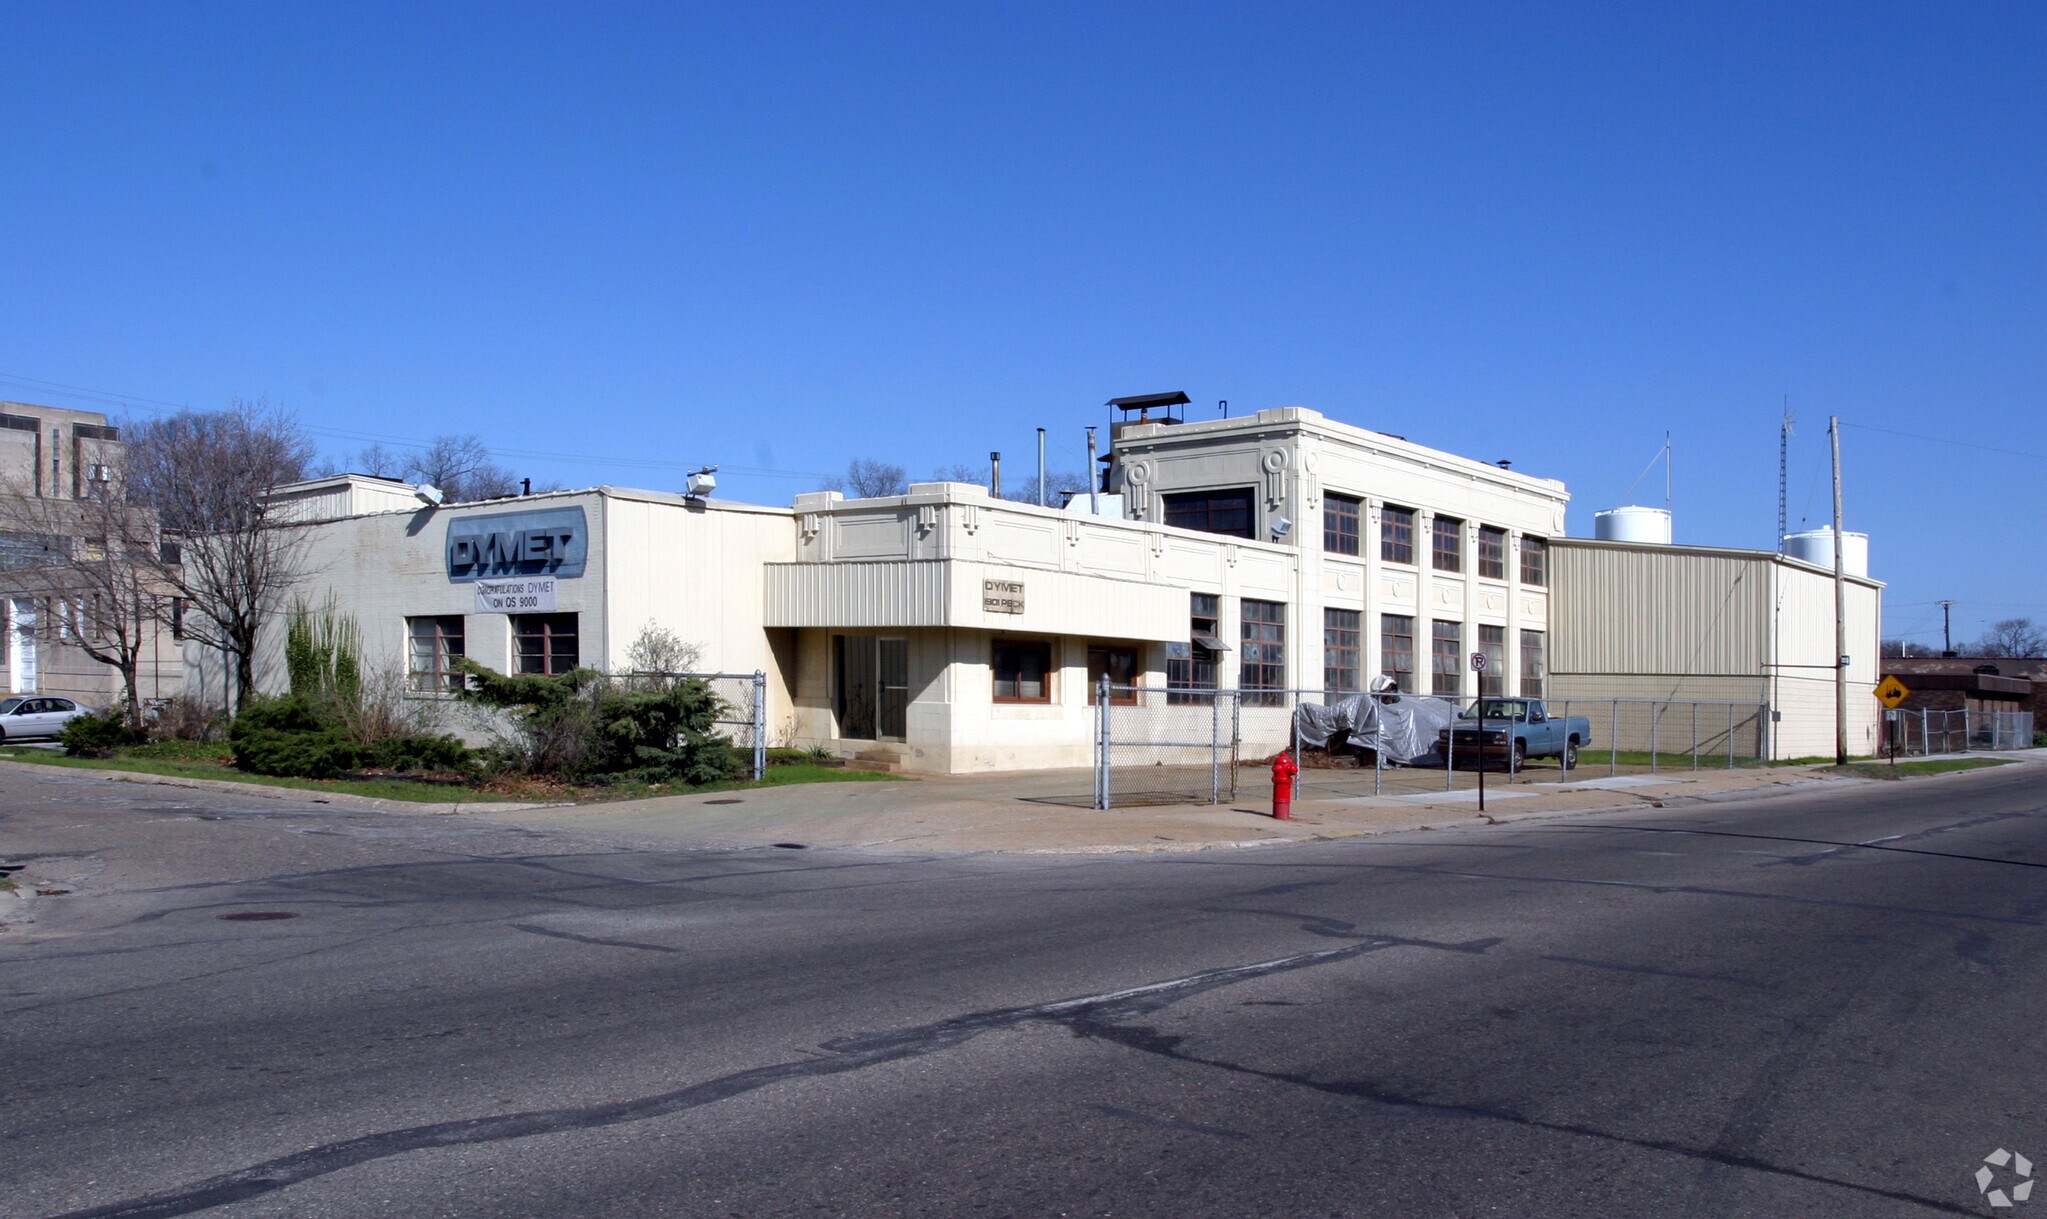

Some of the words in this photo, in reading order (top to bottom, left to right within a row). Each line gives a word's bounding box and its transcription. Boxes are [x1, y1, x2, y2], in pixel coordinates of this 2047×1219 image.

[452, 526, 573, 568] DYMET
[527, 581, 554, 593] DYMET
[985, 581, 1024, 593] DYMET
[493, 598, 503, 608] ON
[505, 597, 516, 607] QS
[519, 596, 538, 607] 9000
[1000, 598, 1024, 608] PECK
